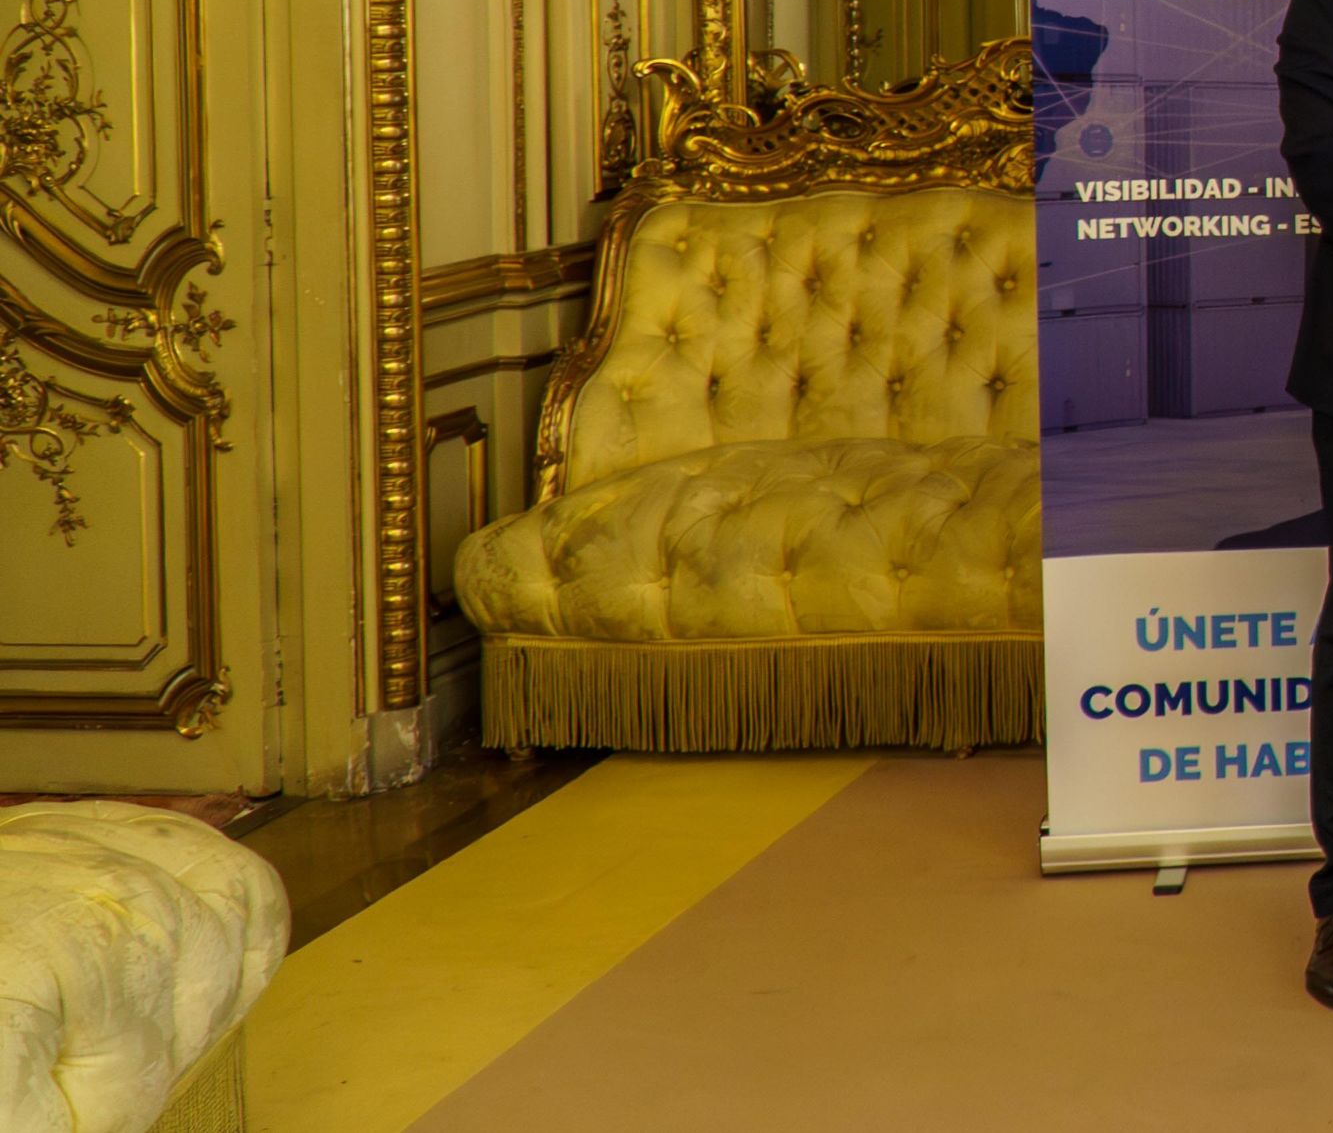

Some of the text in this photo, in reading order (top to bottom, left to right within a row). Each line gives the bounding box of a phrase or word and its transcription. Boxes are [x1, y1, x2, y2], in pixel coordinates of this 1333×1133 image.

[1075, 178, 1242, 202] VISIBILIDAD
[1078, 215, 1271, 240] NETWORKING
[1136, 607, 1297, 652] ÚNETE
[1139, 746, 1201, 783] DE
